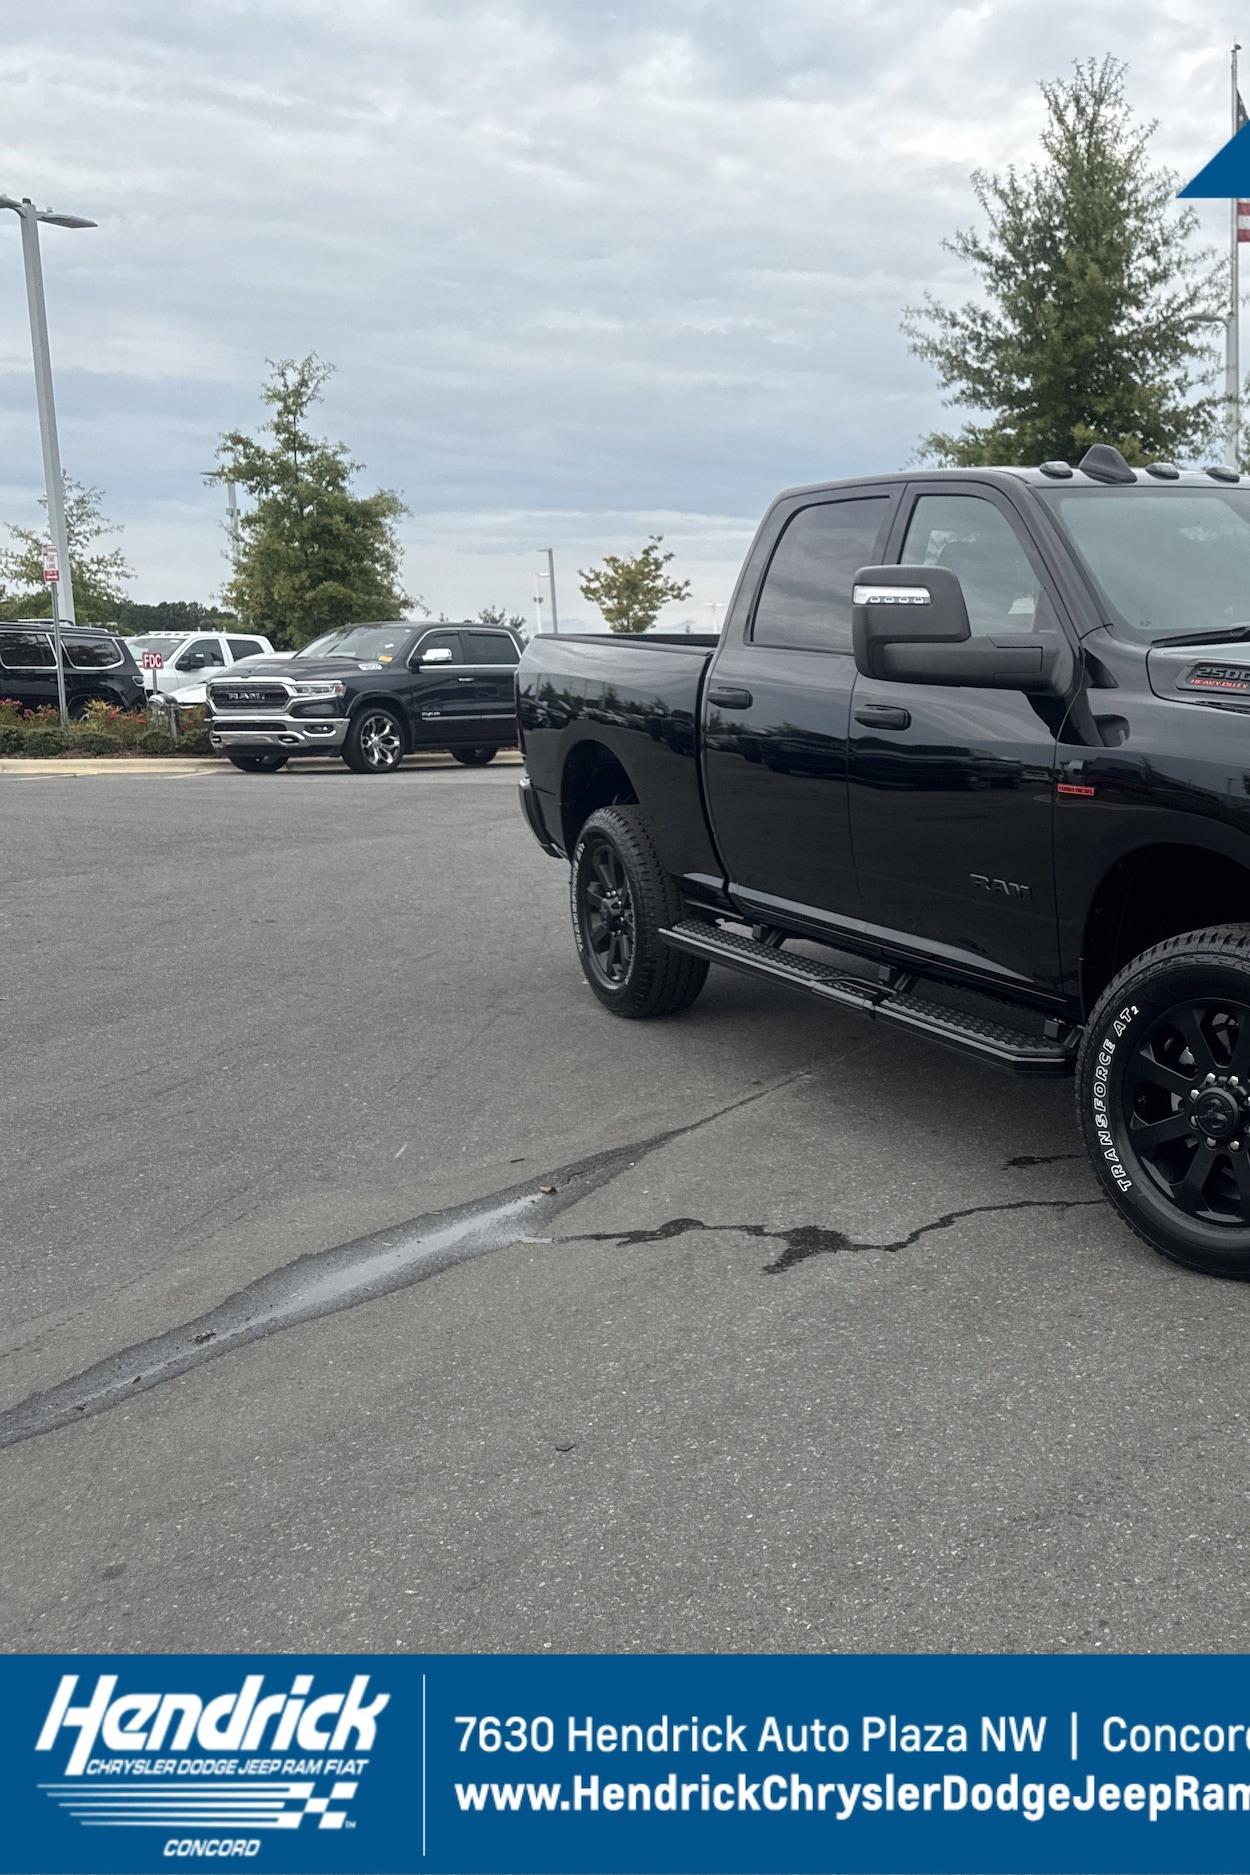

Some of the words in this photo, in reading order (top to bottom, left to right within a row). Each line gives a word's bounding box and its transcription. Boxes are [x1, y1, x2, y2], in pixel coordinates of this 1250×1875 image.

[143, 653, 162, 668] FDC
[1190, 678, 1221, 687] HEAVY
[1221, 681, 1249, 689] DUTY
[228, 691, 261, 700] RAM
[970, 872, 1034, 900] RAM
[1093, 1038, 1133, 1192] TRANSFORCE
